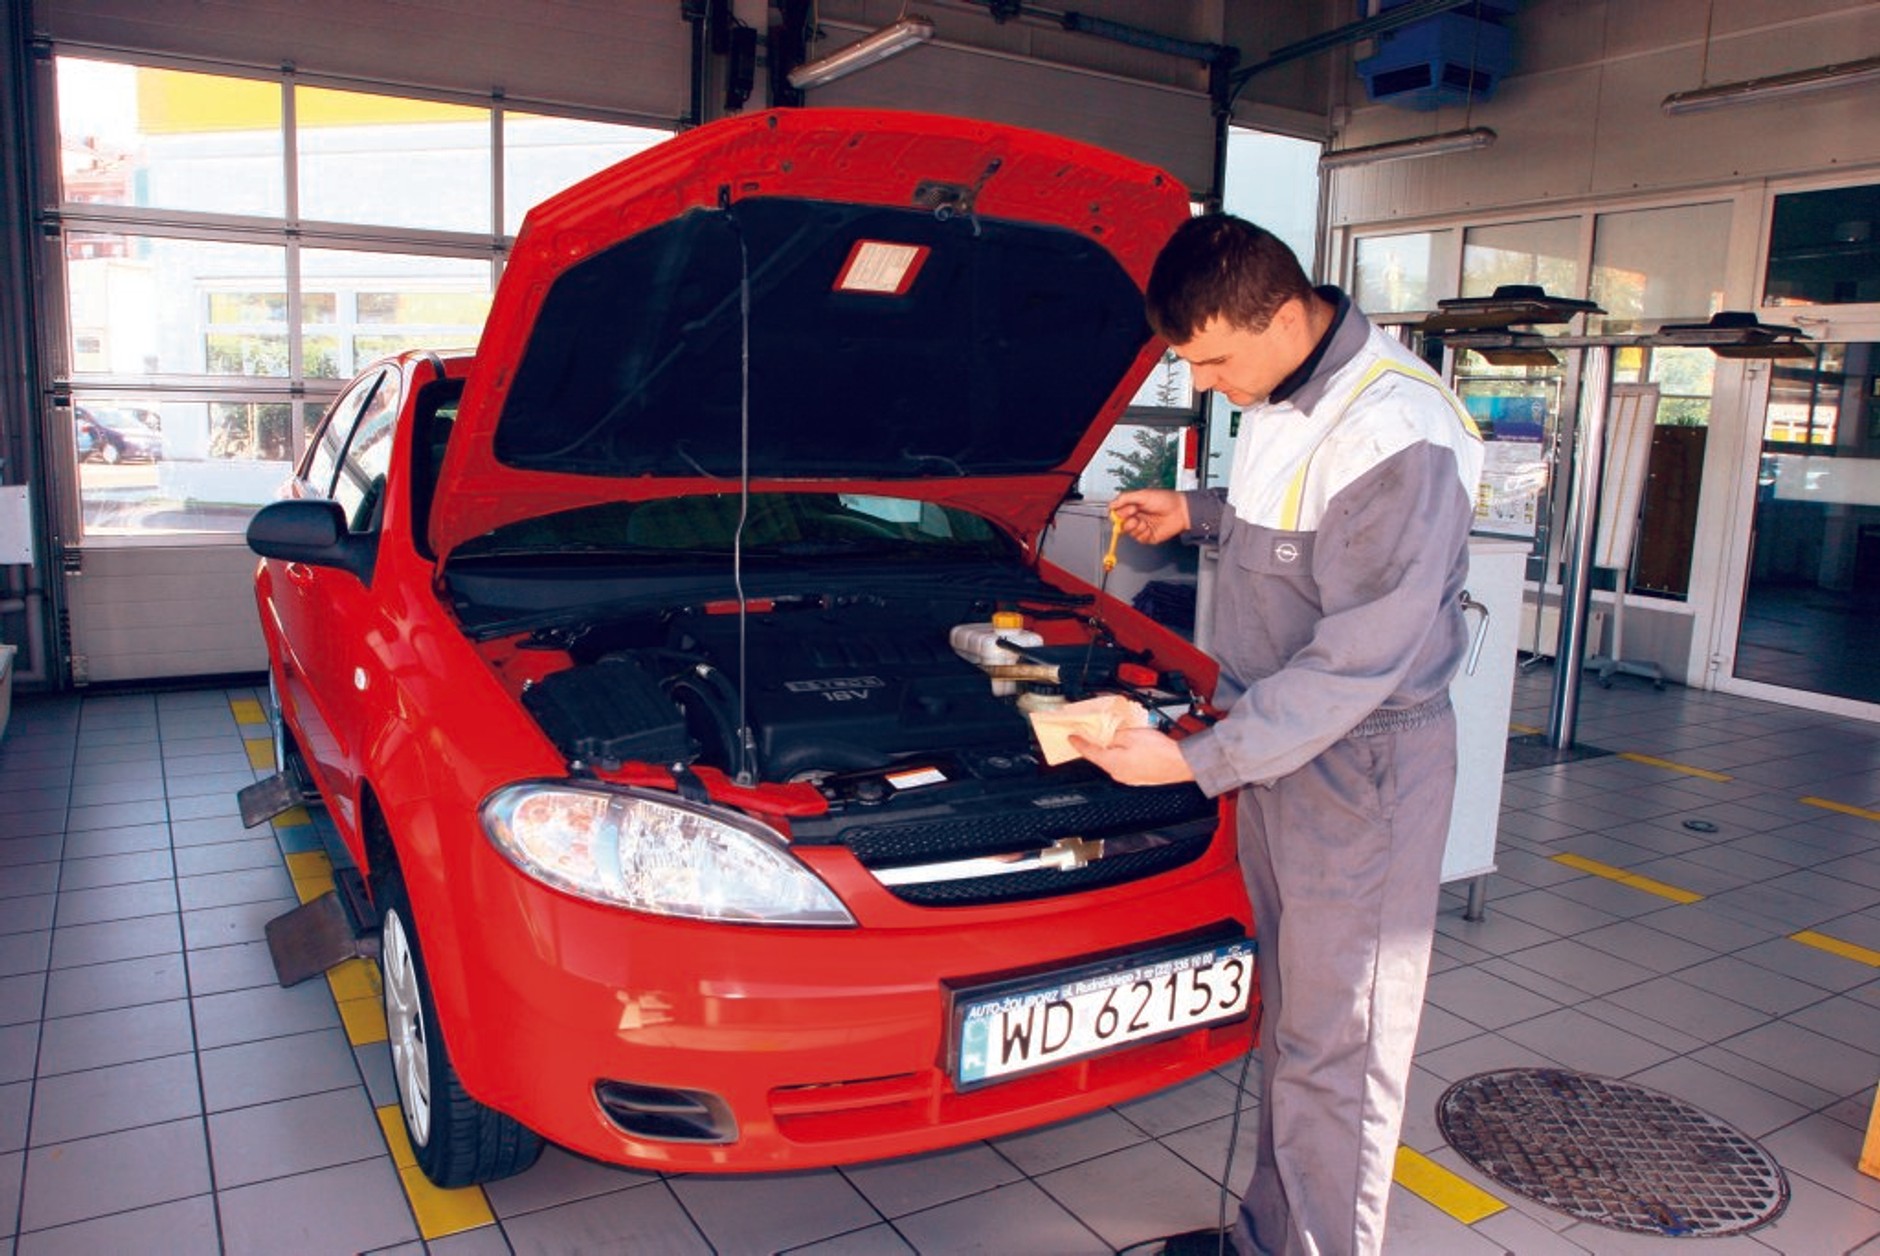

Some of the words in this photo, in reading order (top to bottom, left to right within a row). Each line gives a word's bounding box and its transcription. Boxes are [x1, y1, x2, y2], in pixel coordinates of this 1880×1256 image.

[822, 690, 868, 701] 16V
[1002, 1000, 1073, 1065] WD
[1095, 960, 1244, 1039] 62153
